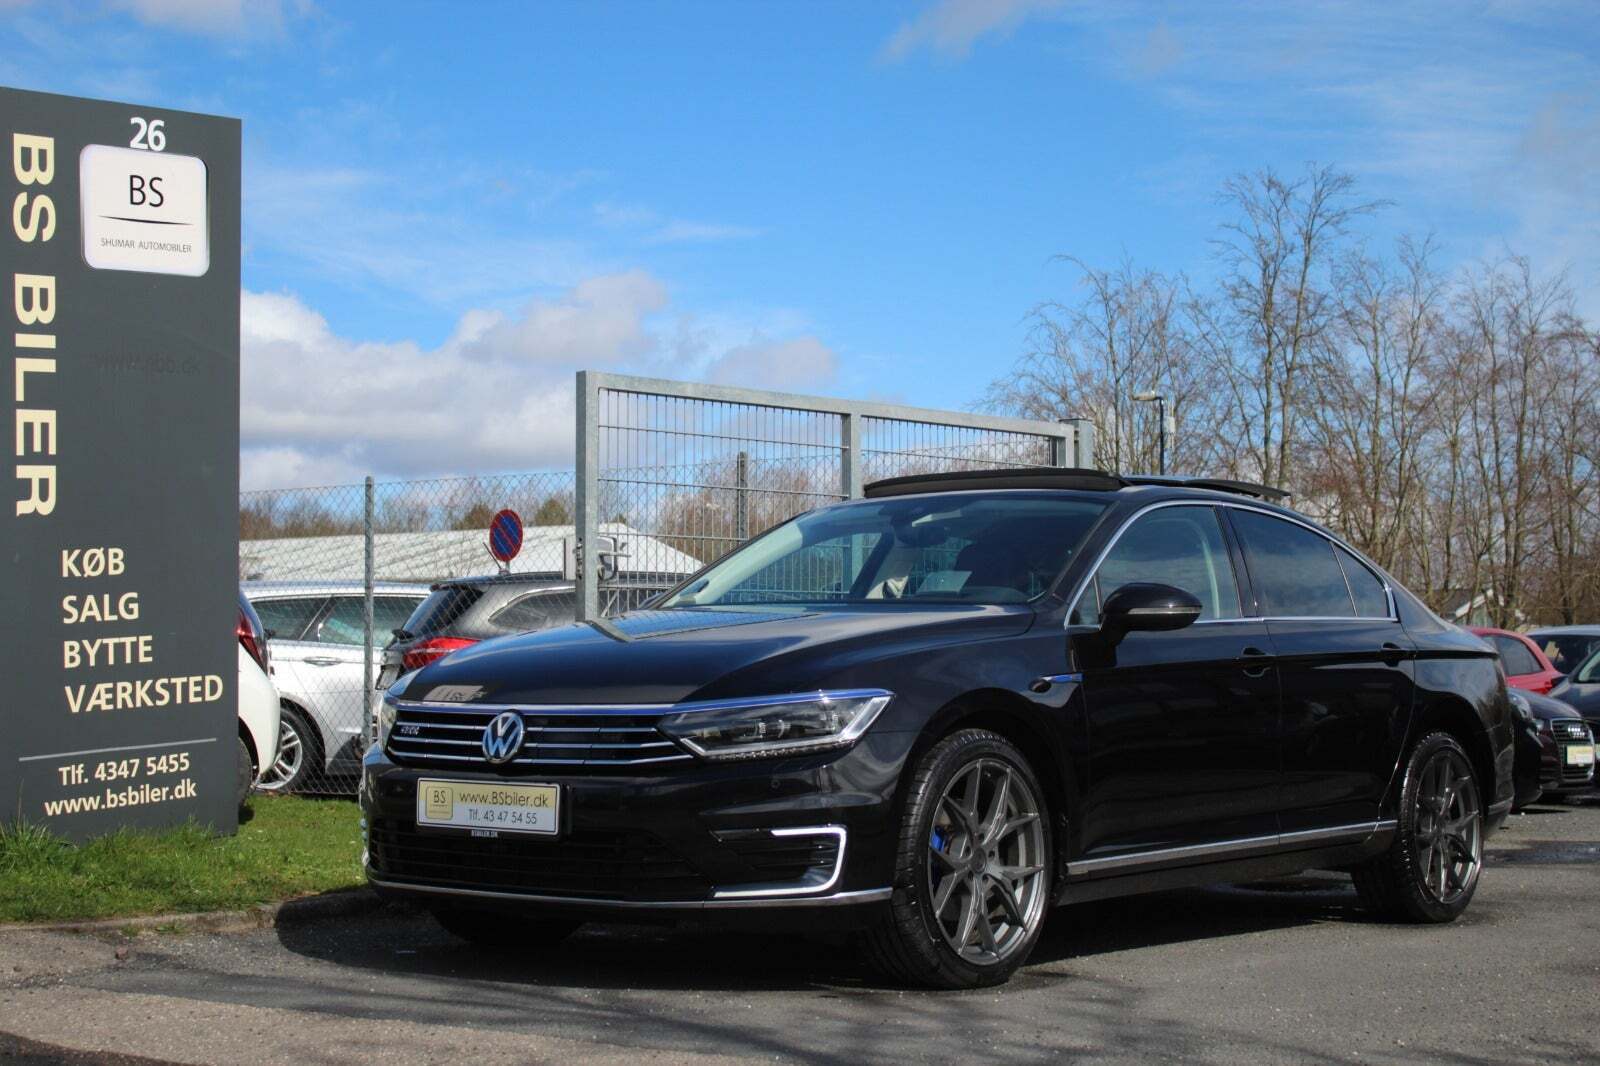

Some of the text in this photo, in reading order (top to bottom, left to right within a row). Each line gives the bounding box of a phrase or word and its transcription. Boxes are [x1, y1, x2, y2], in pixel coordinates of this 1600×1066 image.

[129, 117, 166, 151] 26
[129, 175, 164, 208] BS
[101, 237, 192, 253] SHUMAR AUTOMOBILER
[13, 133, 56, 517] BS BILER
[62, 547, 125, 578] KØB
[62, 592, 139, 624] SALG
[64, 635, 153, 668] BYTTE
[65, 674, 223, 713] VÆRKSTED
[58, 753, 190, 786] Tlf. 4347 5455
[44, 778, 197, 816] www.bsbiler.dk
[433, 790, 446, 803] BS
[459, 791, 549, 808] www.BSbiler.dk
[483, 810, 495, 822] 43
[497, 811, 509, 823] 47
[511, 812, 523, 824] 54
[525, 813, 537, 825] 55
